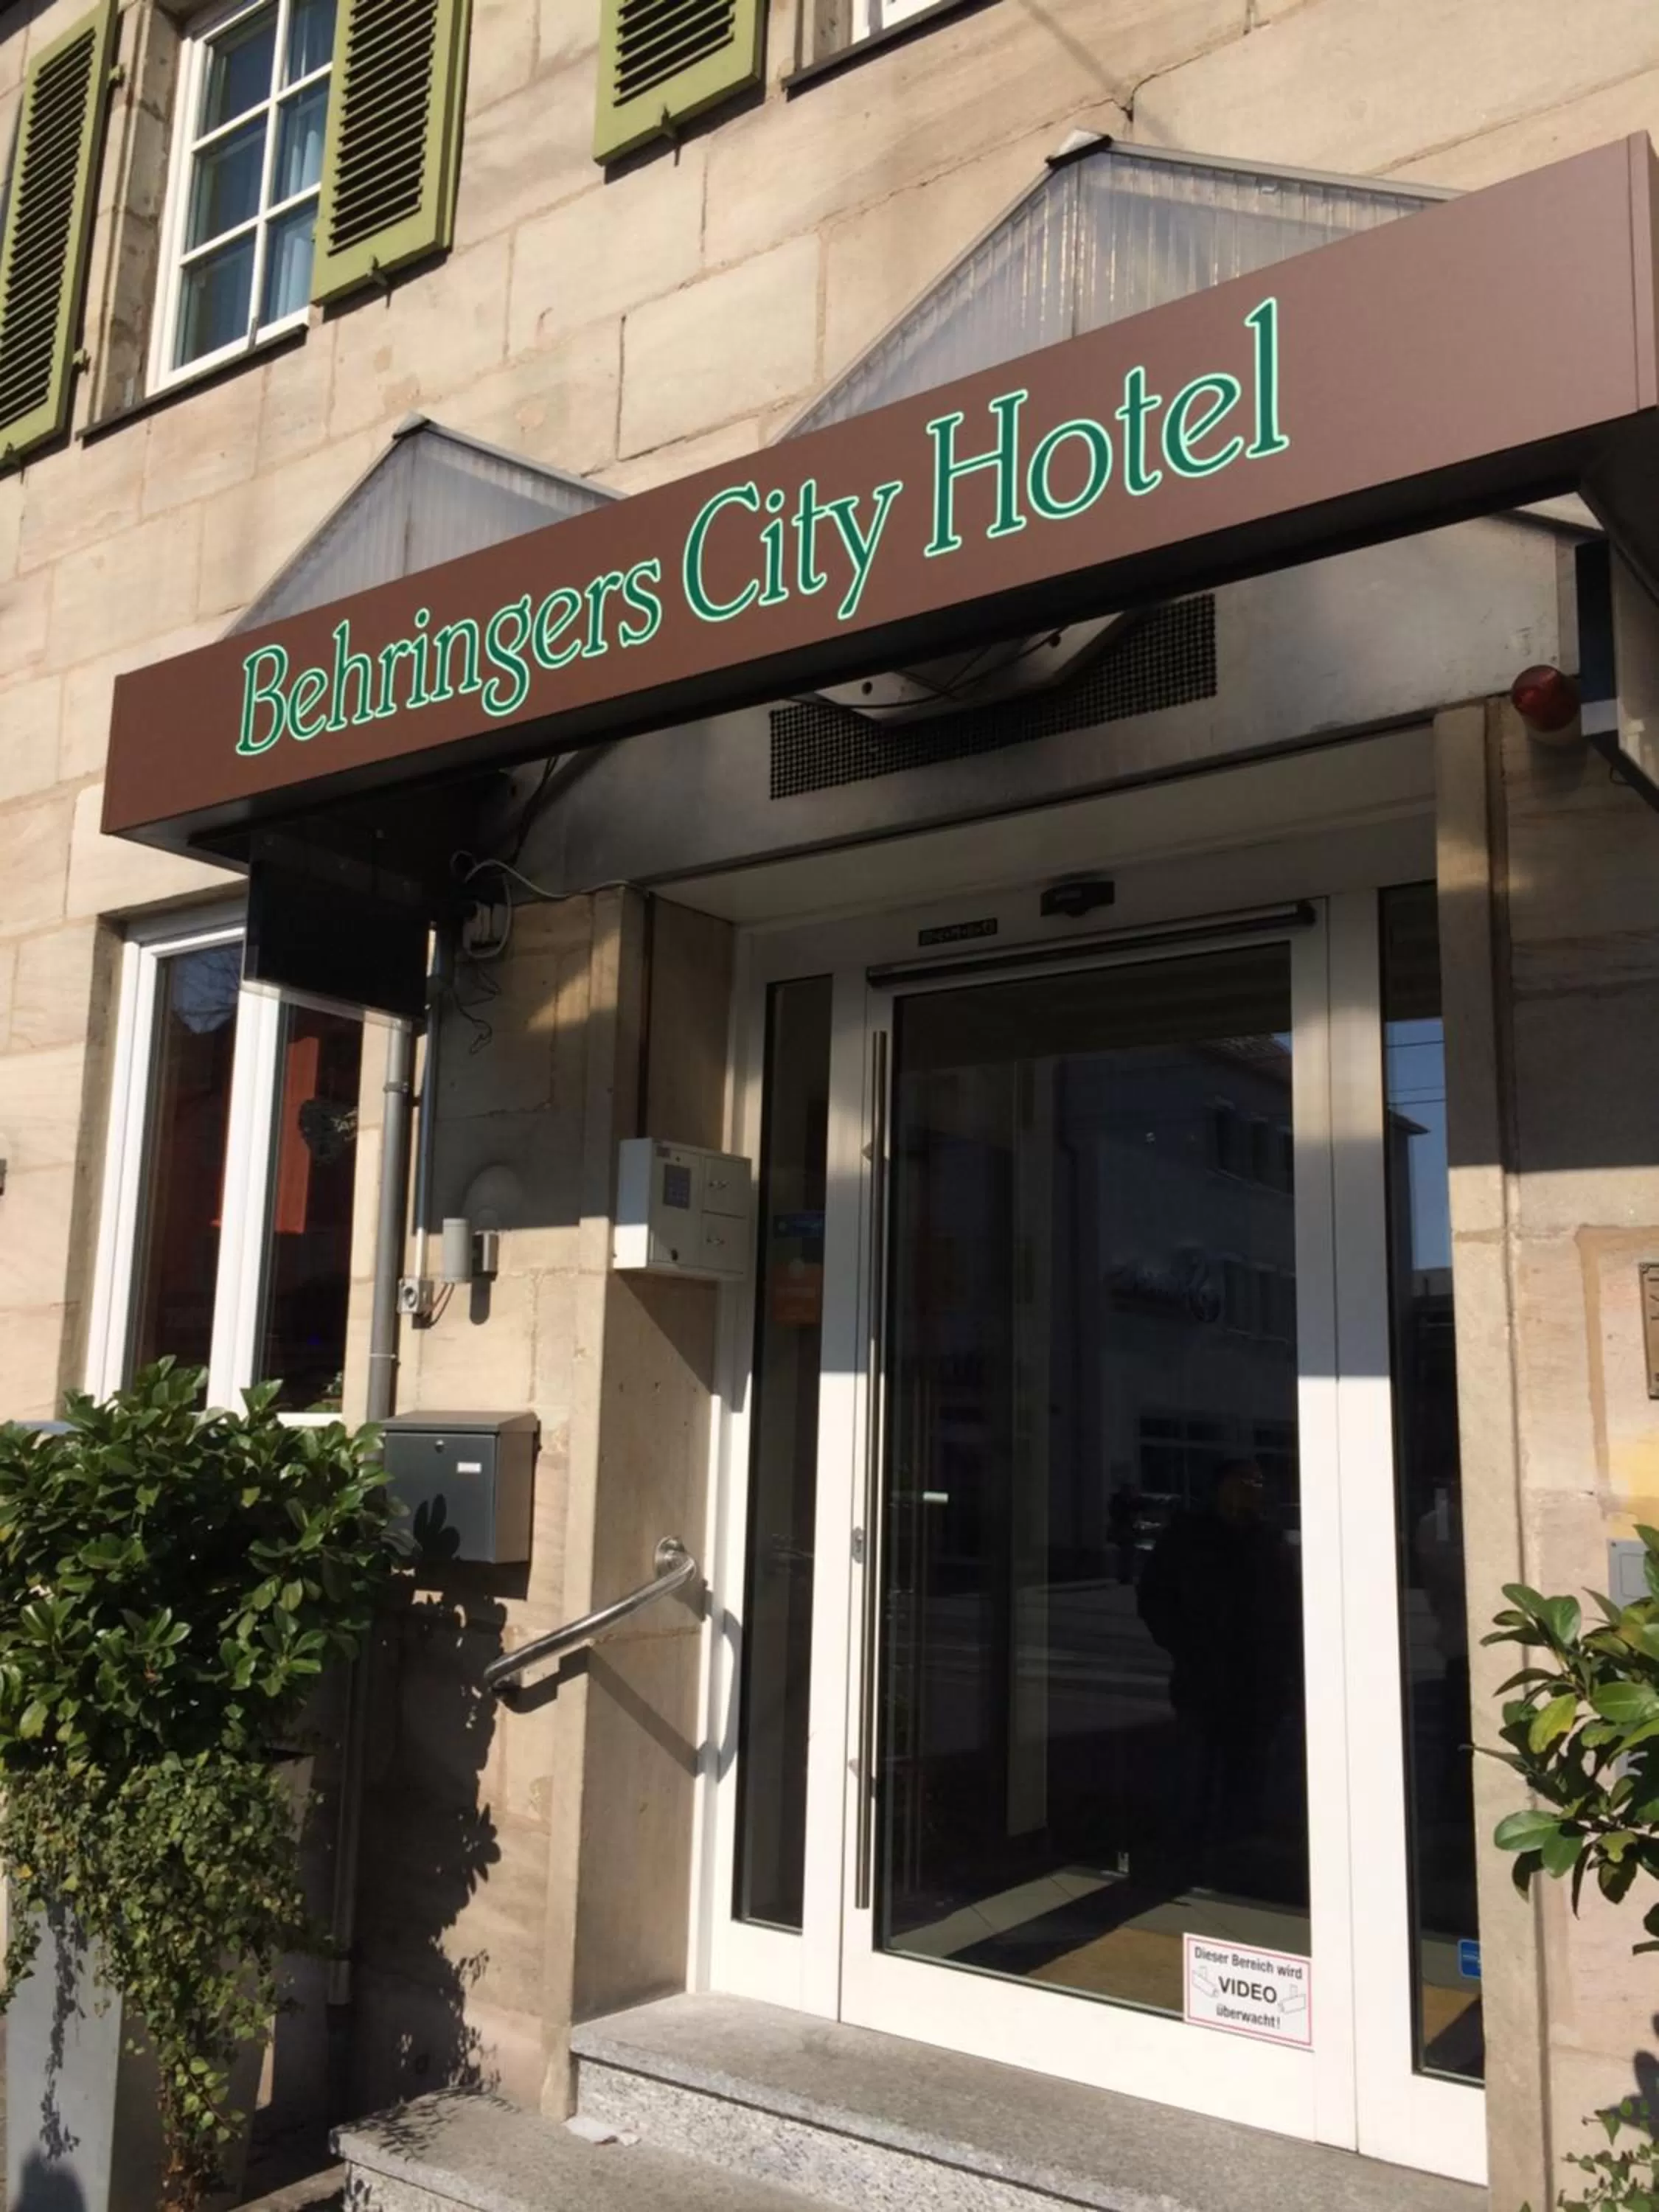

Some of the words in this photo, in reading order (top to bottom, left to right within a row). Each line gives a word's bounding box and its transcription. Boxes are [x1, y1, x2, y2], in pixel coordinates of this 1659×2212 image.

[234, 558, 664, 757] Behringers
[681, 478, 905, 622] City
[923, 296, 1290, 558] Hotel
[1194, 1947, 1228, 1964] Dieser
[1231, 1954, 1274, 1974] Bereich
[1276, 1964, 1303, 1980] wird
[1218, 1975, 1278, 2004] VIDEO
